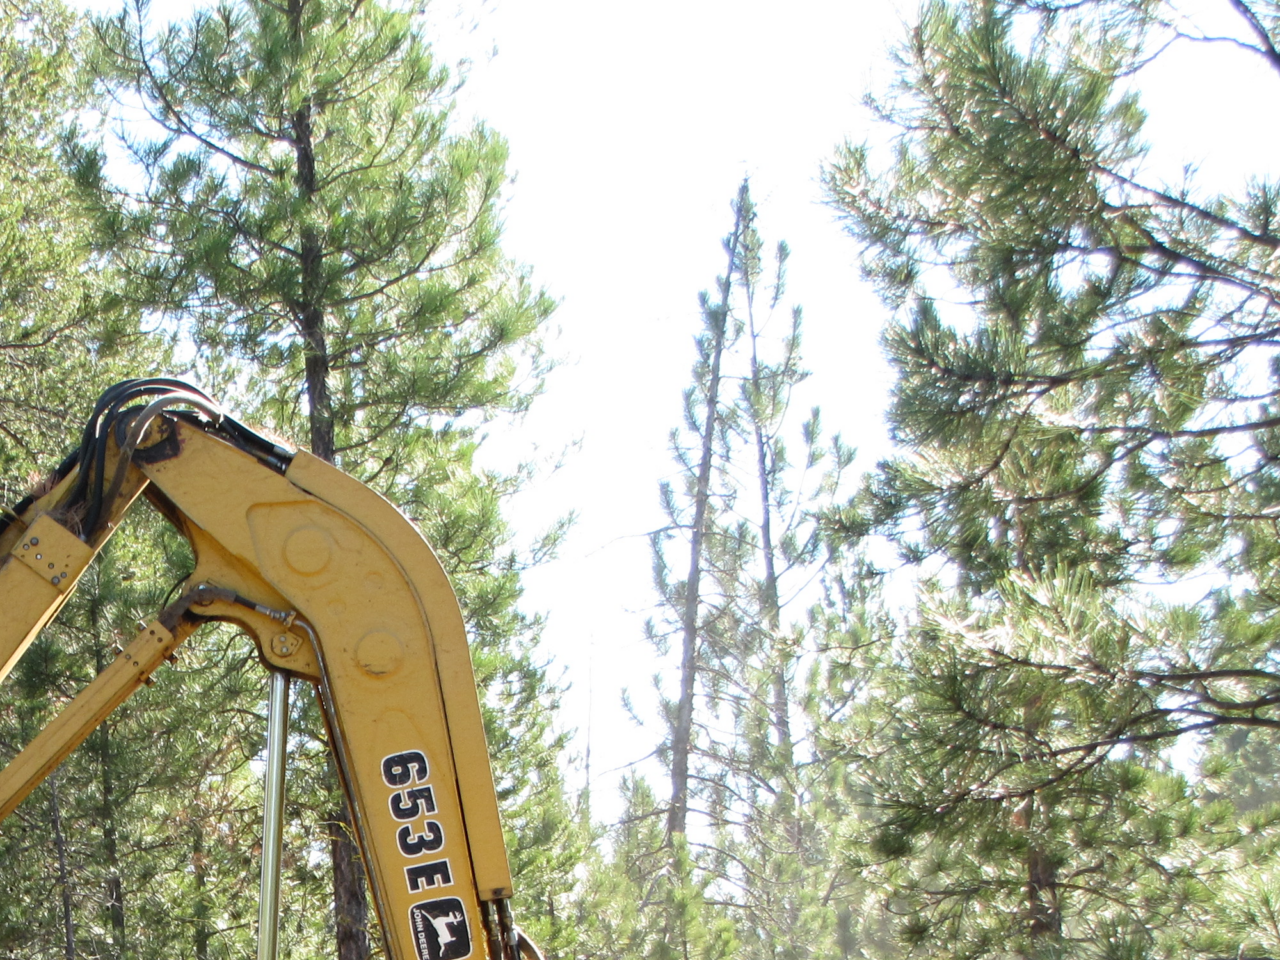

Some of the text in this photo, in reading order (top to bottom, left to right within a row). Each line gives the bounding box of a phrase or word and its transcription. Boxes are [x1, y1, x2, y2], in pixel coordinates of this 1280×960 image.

[381, 749, 455, 894] 653E
[413, 908, 430, 960] JOHN DEERE
